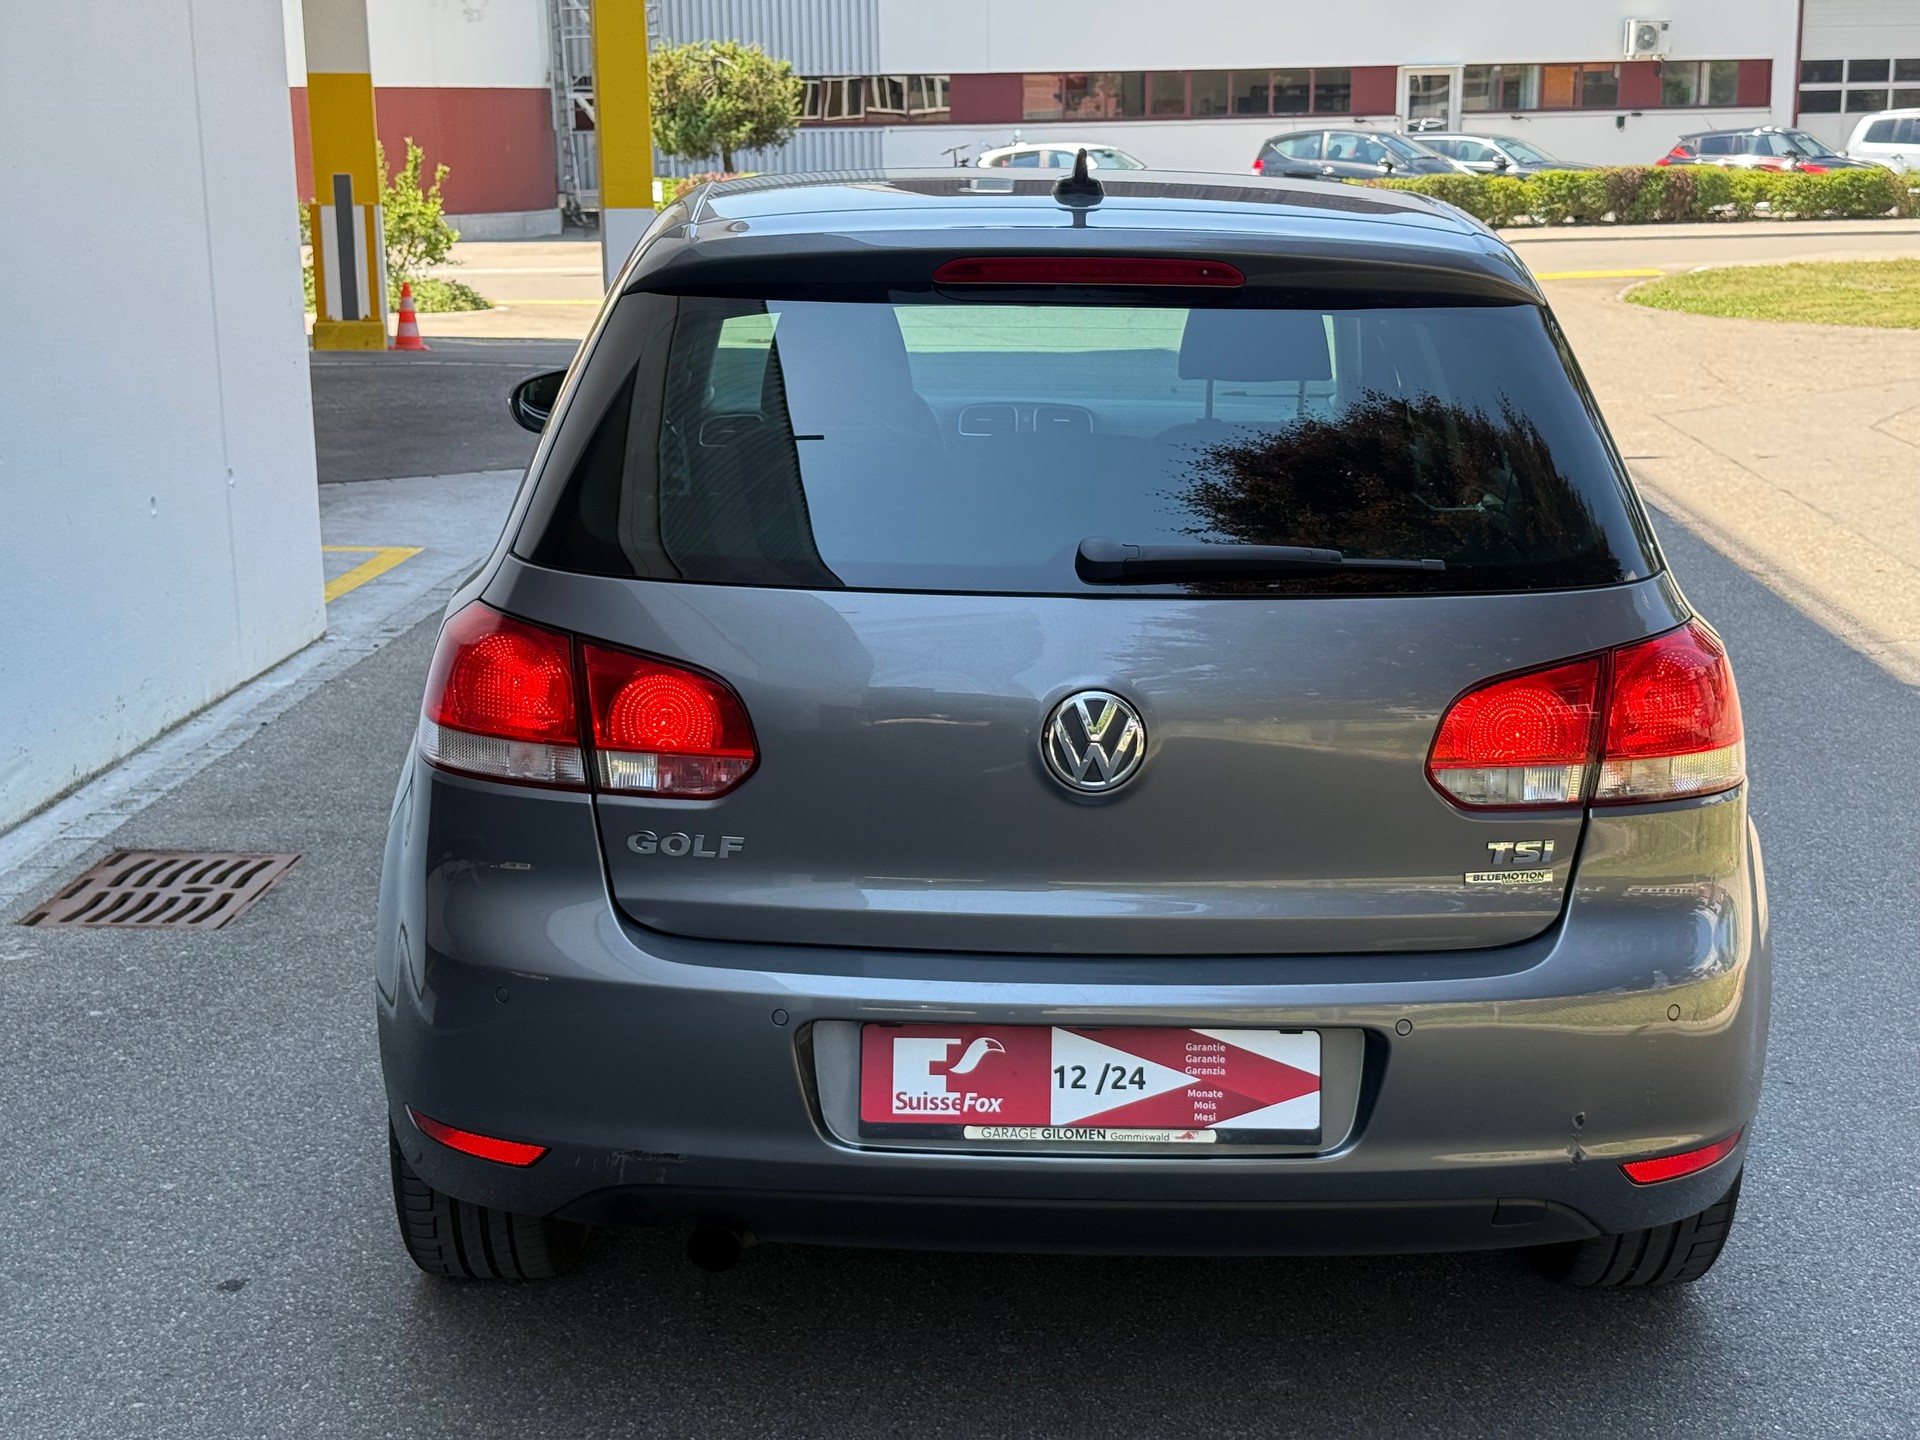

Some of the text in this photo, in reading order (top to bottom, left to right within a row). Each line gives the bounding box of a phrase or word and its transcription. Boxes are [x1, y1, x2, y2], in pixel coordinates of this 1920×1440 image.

[626, 829, 746, 859] GOLF
[1487, 840, 1555, 864] TSI
[1472, 871, 1545, 882] BLUEMOTION
[1185, 1042, 1226, 1052] Garantie
[1185, 1054, 1226, 1064] Garantie
[1185, 1066, 1226, 1076] Garanzia
[1187, 1089, 1224, 1098] Monate
[1193, 1101, 1217, 1110] Mois
[1193, 1113, 1217, 1122] Mesi
[981, 1126, 1170, 1142] GARAGE GILOMEN Gommiswald
